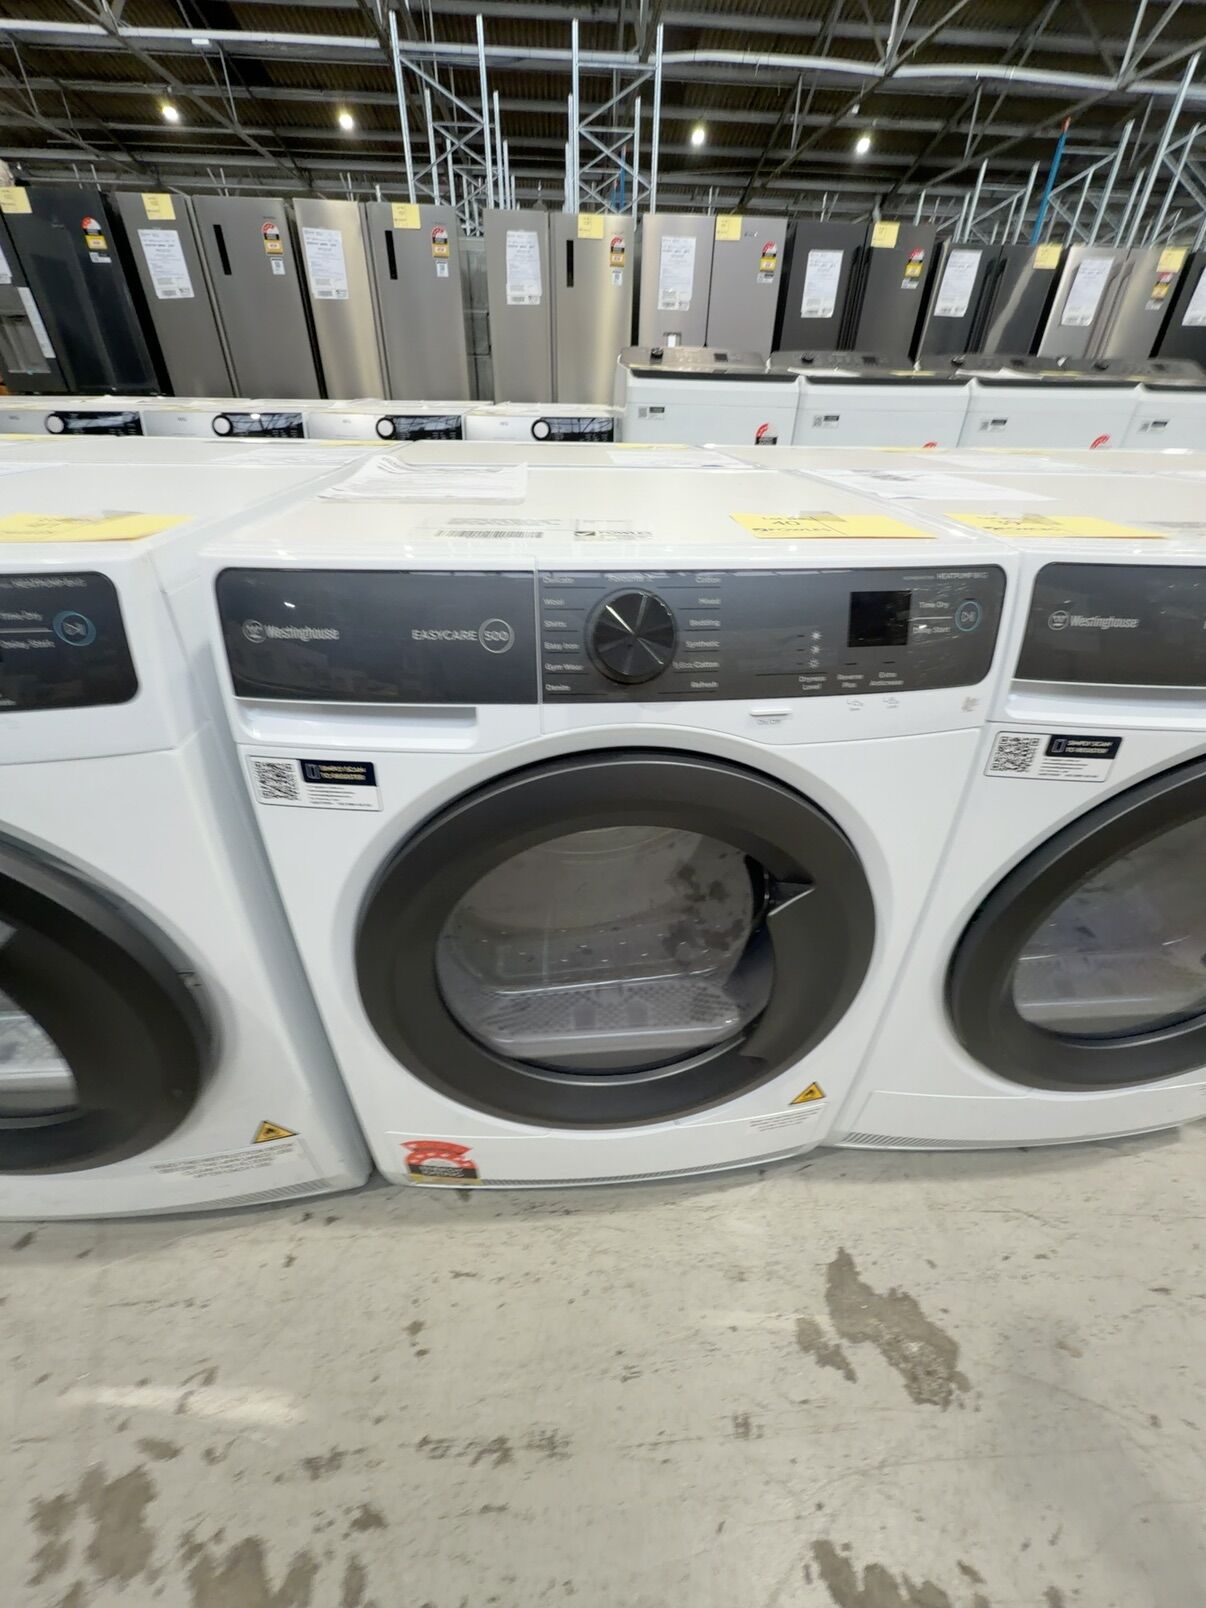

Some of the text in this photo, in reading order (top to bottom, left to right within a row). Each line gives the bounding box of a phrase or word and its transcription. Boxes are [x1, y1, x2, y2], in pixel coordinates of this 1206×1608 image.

[1070, 614, 1140, 630] Westinghouse
[264, 624, 340, 641] Westinghouse
[411, 629, 478, 641] EASYCARE
